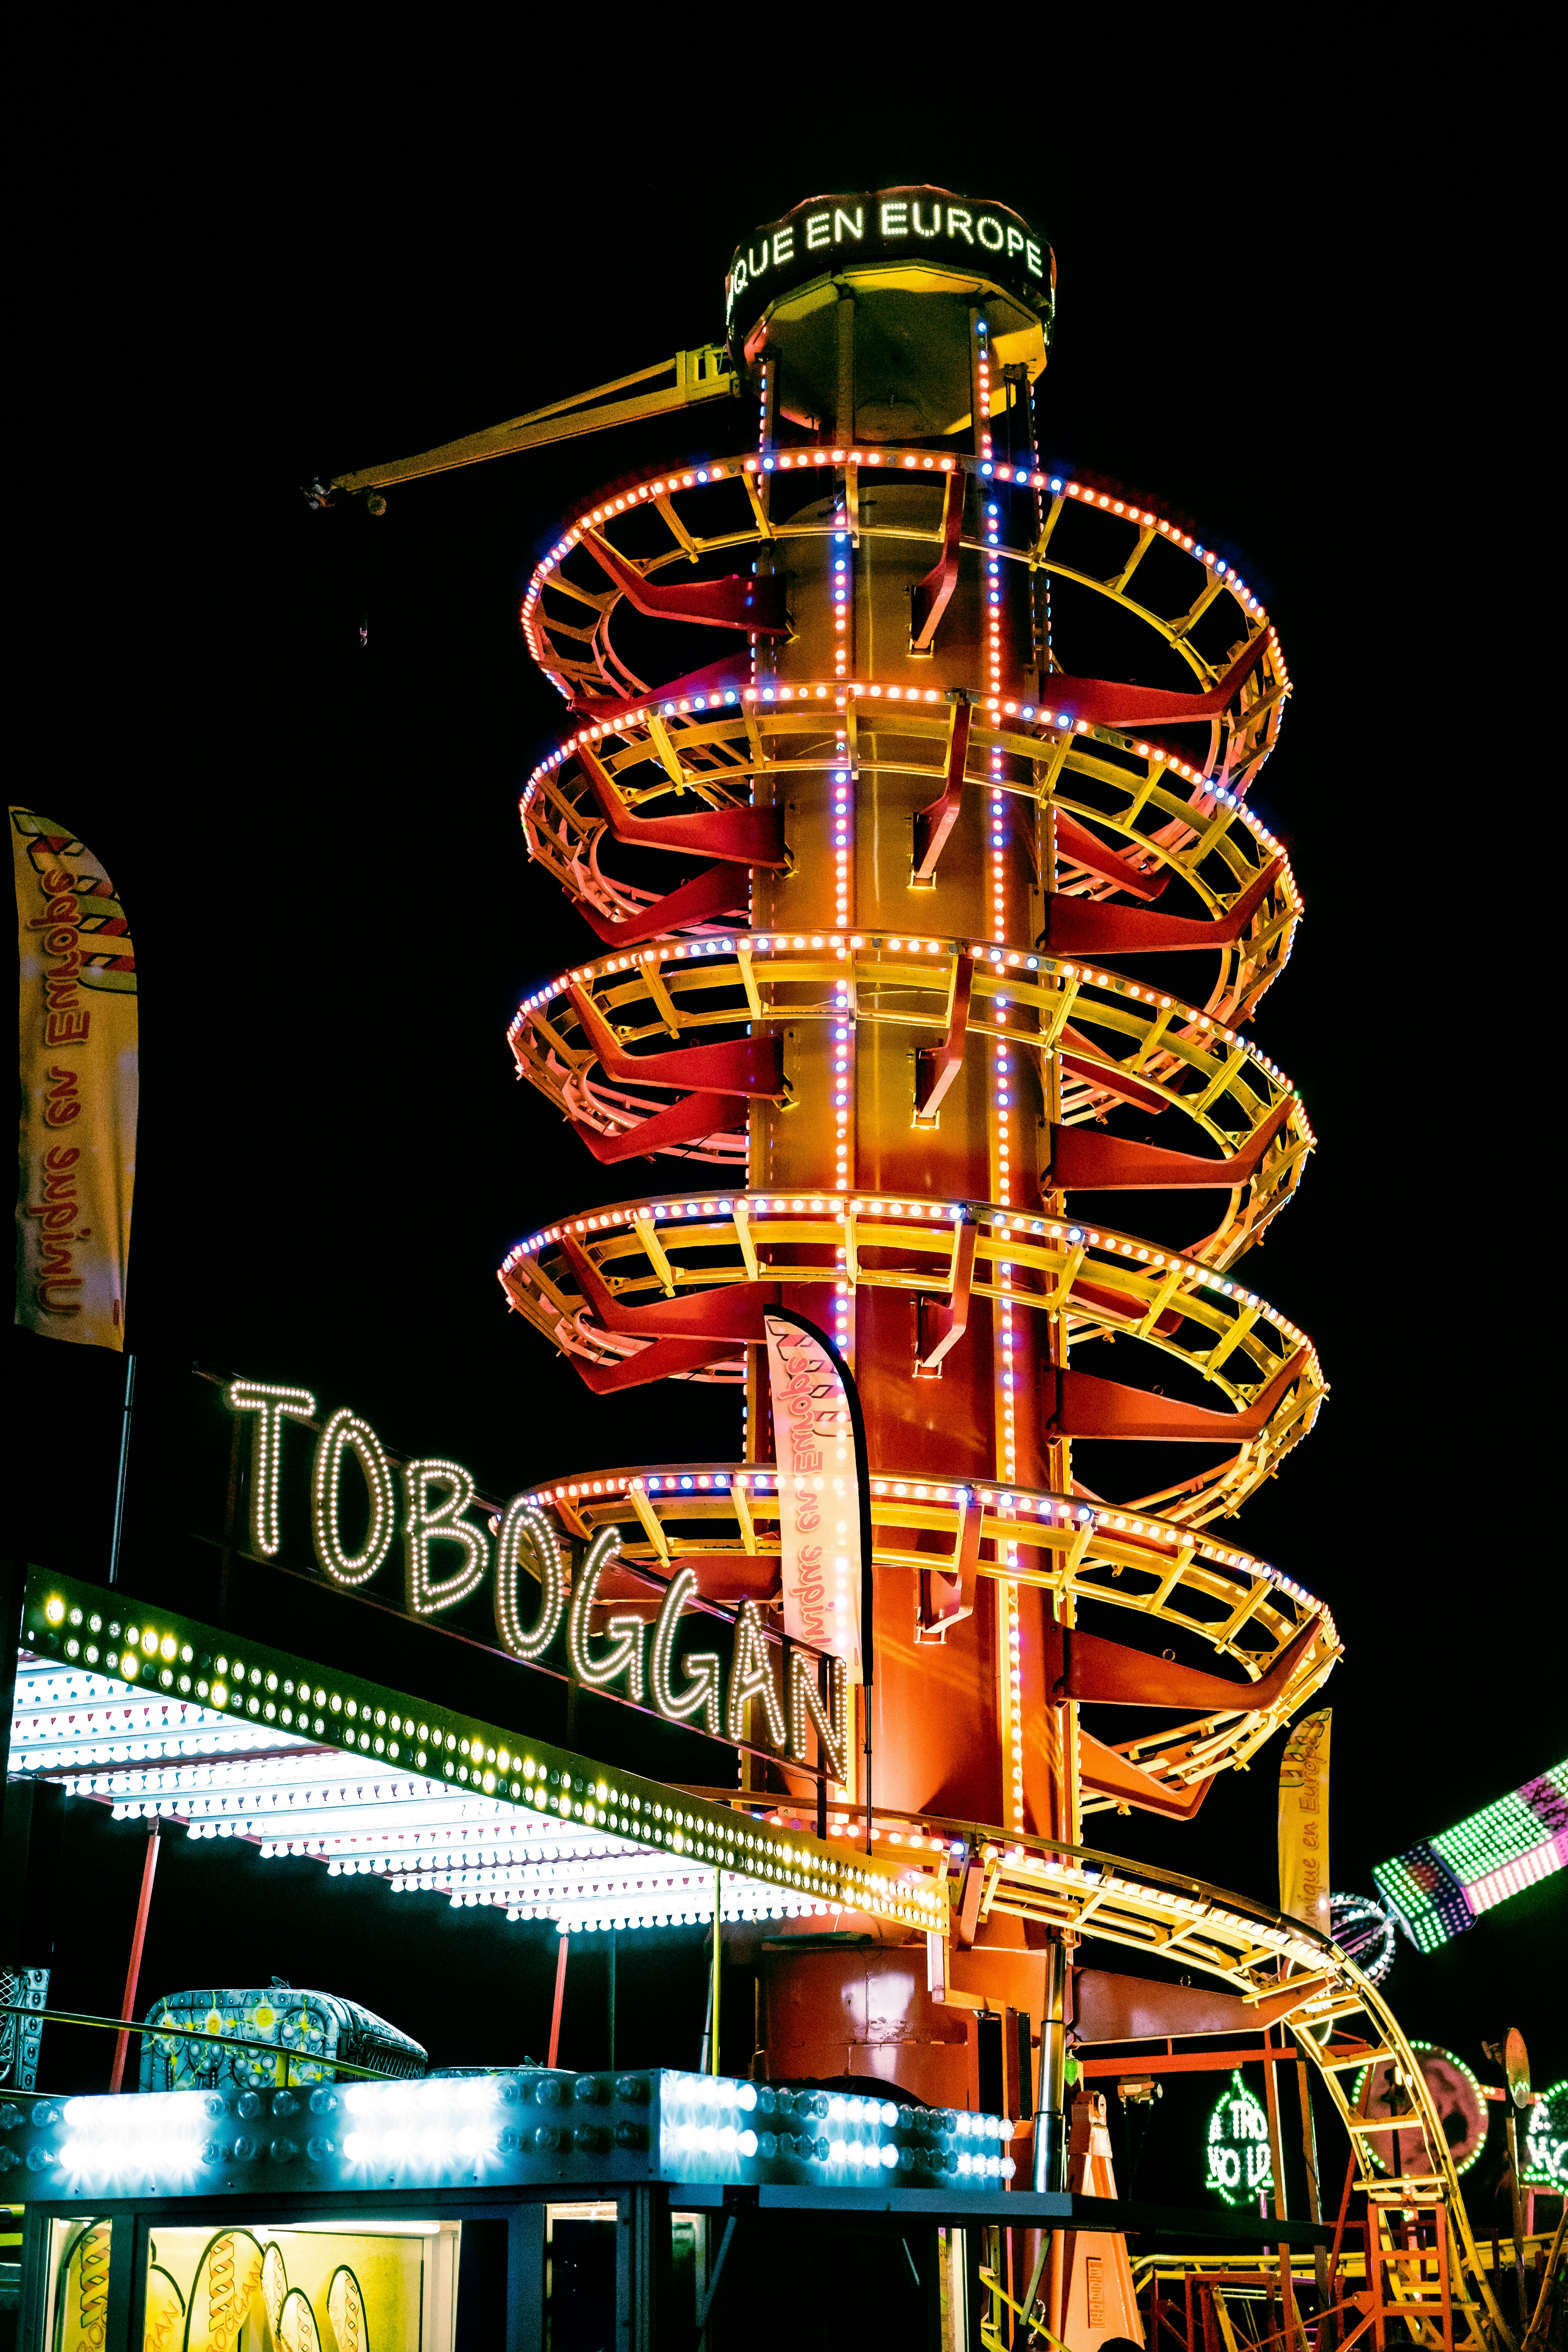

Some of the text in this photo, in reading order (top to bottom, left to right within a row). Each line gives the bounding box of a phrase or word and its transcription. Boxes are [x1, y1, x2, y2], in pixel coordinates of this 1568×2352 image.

[808, 208, 862, 249] EN
[882, 202, 1043, 278] EUROPE
[230, 1380, 847, 1782] TOBOGGAN
[1303, 1822, 1317, 1847] en
